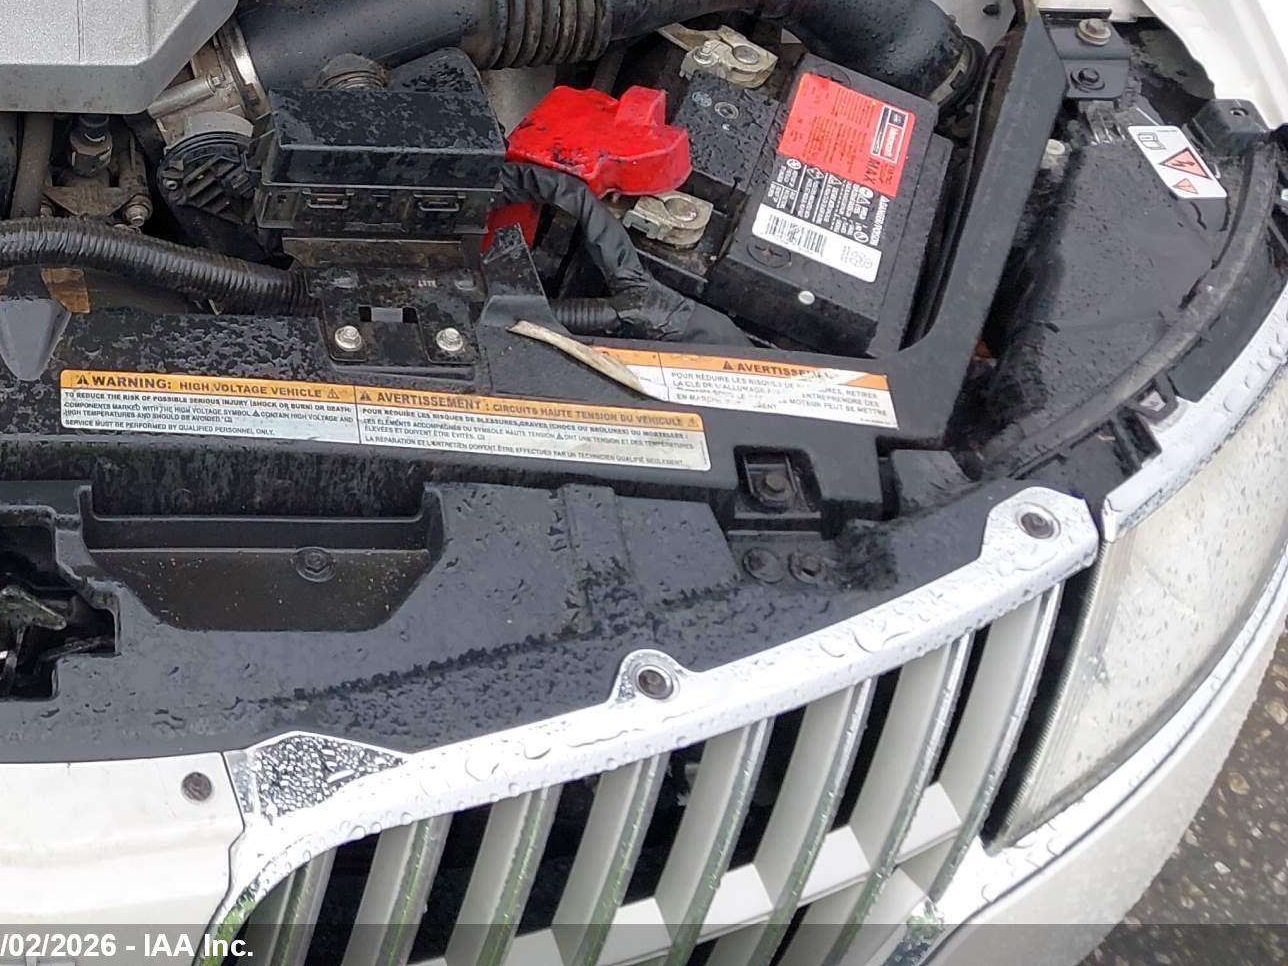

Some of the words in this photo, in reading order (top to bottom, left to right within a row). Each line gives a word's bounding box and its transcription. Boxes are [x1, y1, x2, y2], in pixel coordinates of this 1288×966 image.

[737, 362, 834, 379] AVERTISSE
[92, 375, 172, 390] WARNING:
[179, 381, 210, 392] HIGH
[213, 383, 268, 395] VOLTAGE
[272, 385, 323, 398] VEHICLE
[65, 391, 75, 399] TO
[76, 392, 106, 400] REDUCE
[122, 393, 140, 402] RISK
[141, 394, 152, 402] OF
[152, 395, 188, 404] POSSIBLE
[189, 396, 220, 405] SERIOUS
[221, 398, 248, 407] INJURY
[278, 401, 290, 409] OR
[377, 391, 482, 411] AVERTISSEMENT
[492, 403, 538, 416] CIRCUITS
[540, 407, 573, 419] HAUTE
[576, 410, 618, 423] TENSION
[620, 413, 635, 423] DU
[636, 413, 683, 427] VÉHICULE
[63, 401, 112, 410] COMPONENTS
[112, 403, 140, 412] MARKED
[174, 406, 191, 414] HIGH
[192, 407, 222, 416] VOLTAGE
[223, 409, 252, 417] SYMBOL
[260, 411, 290, 420] CONTAIN
[291, 413, 308, 421] HIGH
[309, 414, 338, 422] VOLTAGE
[64, 409, 82, 417] HIGH
[83, 410, 136, 419] TEMPERATURES
[137, 412, 152, 420] AND
[152, 413, 180, 421] SHOULD
[65, 419, 93, 427] SERVICE
[94, 420, 113, 428] MUST
[125, 421, 167, 430] PERFORMED
[167, 423, 178, 431] BY
[178, 424, 214, 433] QUALIFIED
[214, 426, 256, 435] PERSONNEL
[362, 408, 383, 416] POUR
[384, 408, 416, 418] RÉDUIRE
[417, 411, 431, 419] LES
[432, 412, 464, 422] RISQUES
[465, 414, 476, 422] DE
[577, 424, 588, 432] OU
[631, 428, 642, 436] OU
[404, 428, 433, 436] DOIVENT
[473, 426, 503, 435] SYMBOLE
[504, 428, 527, 436] HAUTE
[527, 430, 555, 439] TENSION
[563, 433, 577, 442] ONT
[578, 435, 592, 443] UNE
[593, 436, 620, 445] TENSION
[620, 438, 629, 446] ET
[630, 439, 644, 447] DES
[469, 443, 497, 451] DOIVENT
[553, 450, 566, 458] PAR
[567, 451, 577, 459] UN
[578, 452, 615, 461] TECHNICIEN
